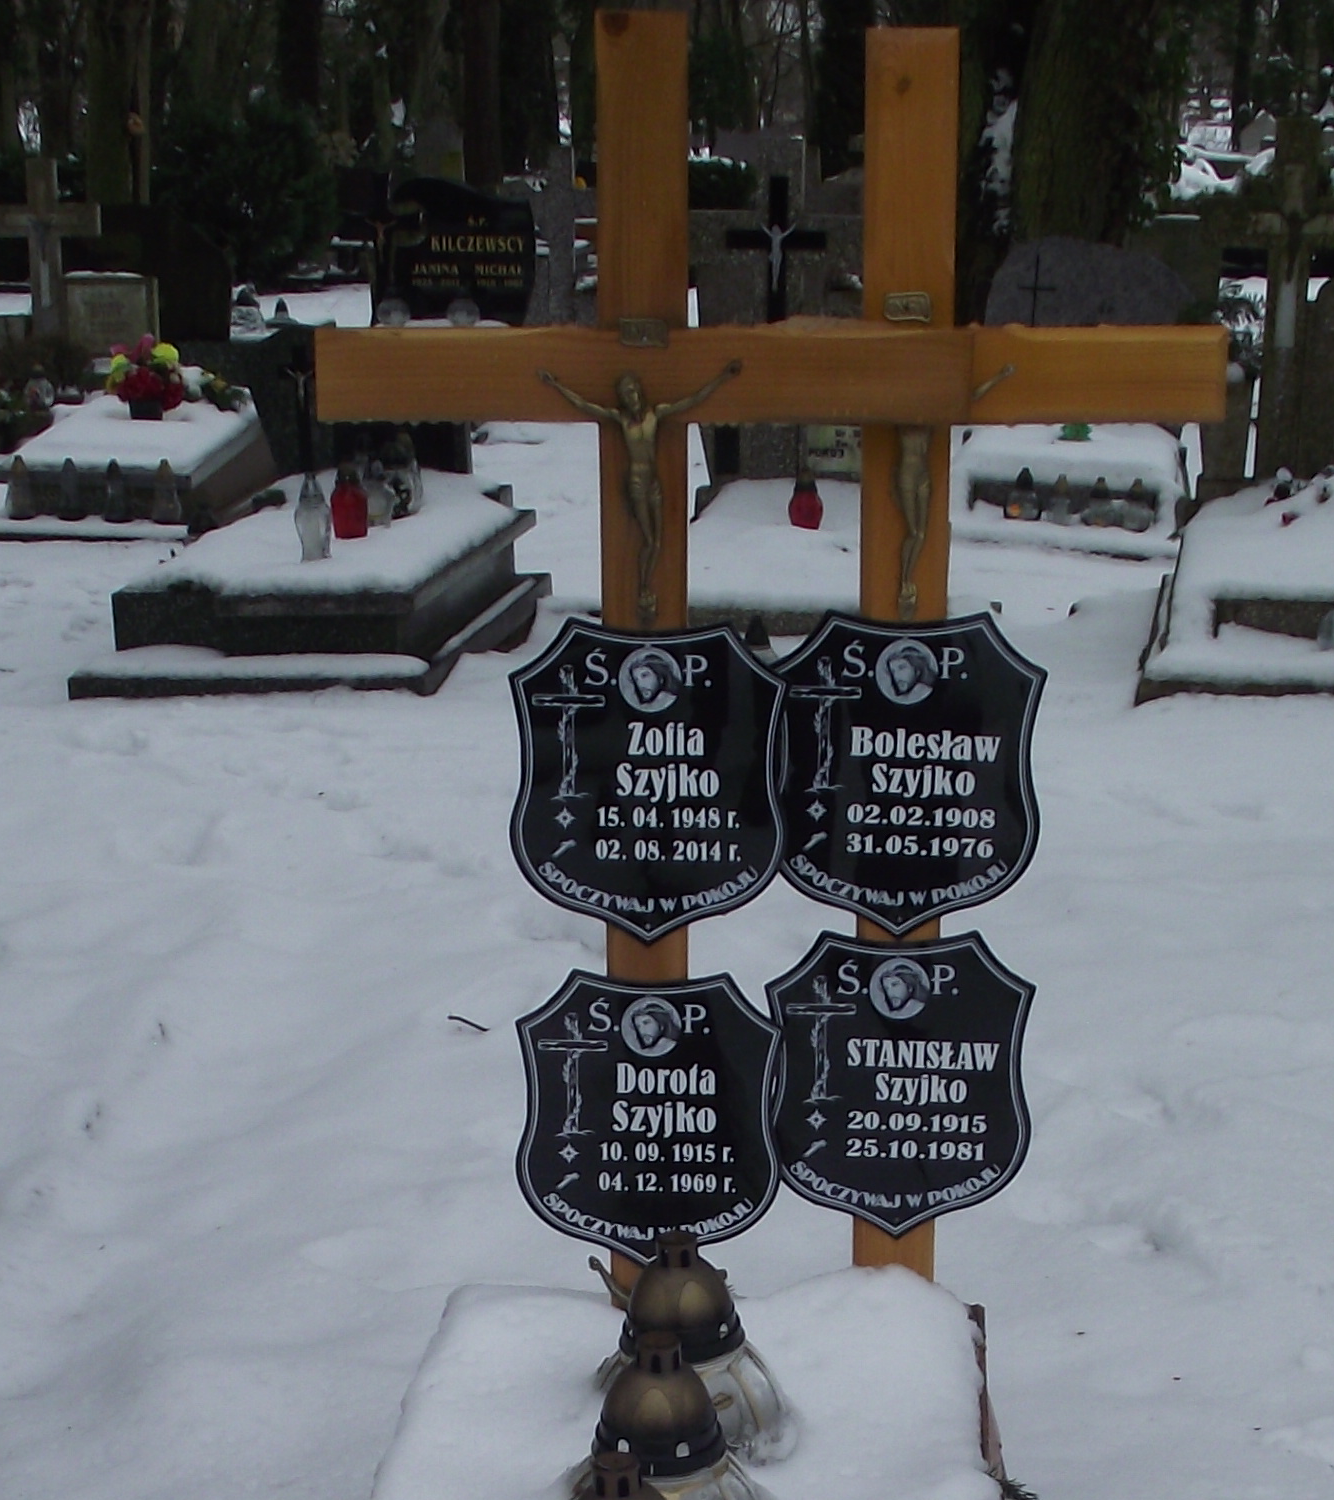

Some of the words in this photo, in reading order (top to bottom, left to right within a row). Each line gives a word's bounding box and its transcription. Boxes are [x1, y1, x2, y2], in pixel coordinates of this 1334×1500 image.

[431, 235, 524, 253] KILCZEWSCY
[412, 263, 460, 276] JANINA
[584, 648, 617, 686] Ś.
[683, 654, 712, 688] P.
[842, 639, 874, 678] Ś.
[939, 647, 968, 680] P.
[627, 721, 704, 756] Zofia
[850, 726, 1001, 763] Bolesław
[616, 763, 720, 803] Szyjko
[871, 763, 976, 799] Szyjko
[596, 806, 625, 828] 15.
[632, 807, 664, 828] 04.
[671, 807, 720, 829] 1948
[726, 811, 740, 829] r.
[846, 803, 996, 829] 02.02.1908
[595, 839, 627, 861] 02.
[634, 840, 666, 861] 08.
[672, 840, 721, 862] 2014
[728, 844, 742, 862] r.
[846, 832, 995, 859] 31.05.1976
[538, 861, 655, 913] SPOCZYWAJ
[658, 897, 678, 913] W
[682, 865, 759, 911] POKOJU
[790, 853, 905, 906] SPOCZYWAJ
[909, 890, 928, 906] W
[931, 859, 1009, 904] POKOJU
[836, 959, 869, 995] Ś.
[931, 964, 959, 996] P.
[588, 997, 620, 1032] Ś.
[682, 1004, 710, 1035] P.
[846, 1037, 1000, 1072] STANISŁAW
[616, 1062, 716, 1096] Dorota
[875, 1073, 968, 1106] Szyjko
[612, 1101, 717, 1138] Szyjko
[846, 1110, 987, 1134] 20.09.1915
[599, 1142, 628, 1161] 10.
[634, 1142, 665, 1162] 09.
[671, 1143, 716, 1163] 1915
[722, 1147, 735, 1163] r.
[845, 1137, 985, 1161] 25.10.1981
[598, 1172, 629, 1191] 04.
[635, 1172, 664, 1192] 12.
[670, 1173, 717, 1193] 1969
[723, 1176, 737, 1194] r.
[790, 1160, 901, 1209] SPOCZYWAJ
[905, 1193, 923, 1208] W
[927, 1163, 1001, 1206] POKOJU
[543, 1192, 654, 1241] SPOCZYWAJ
